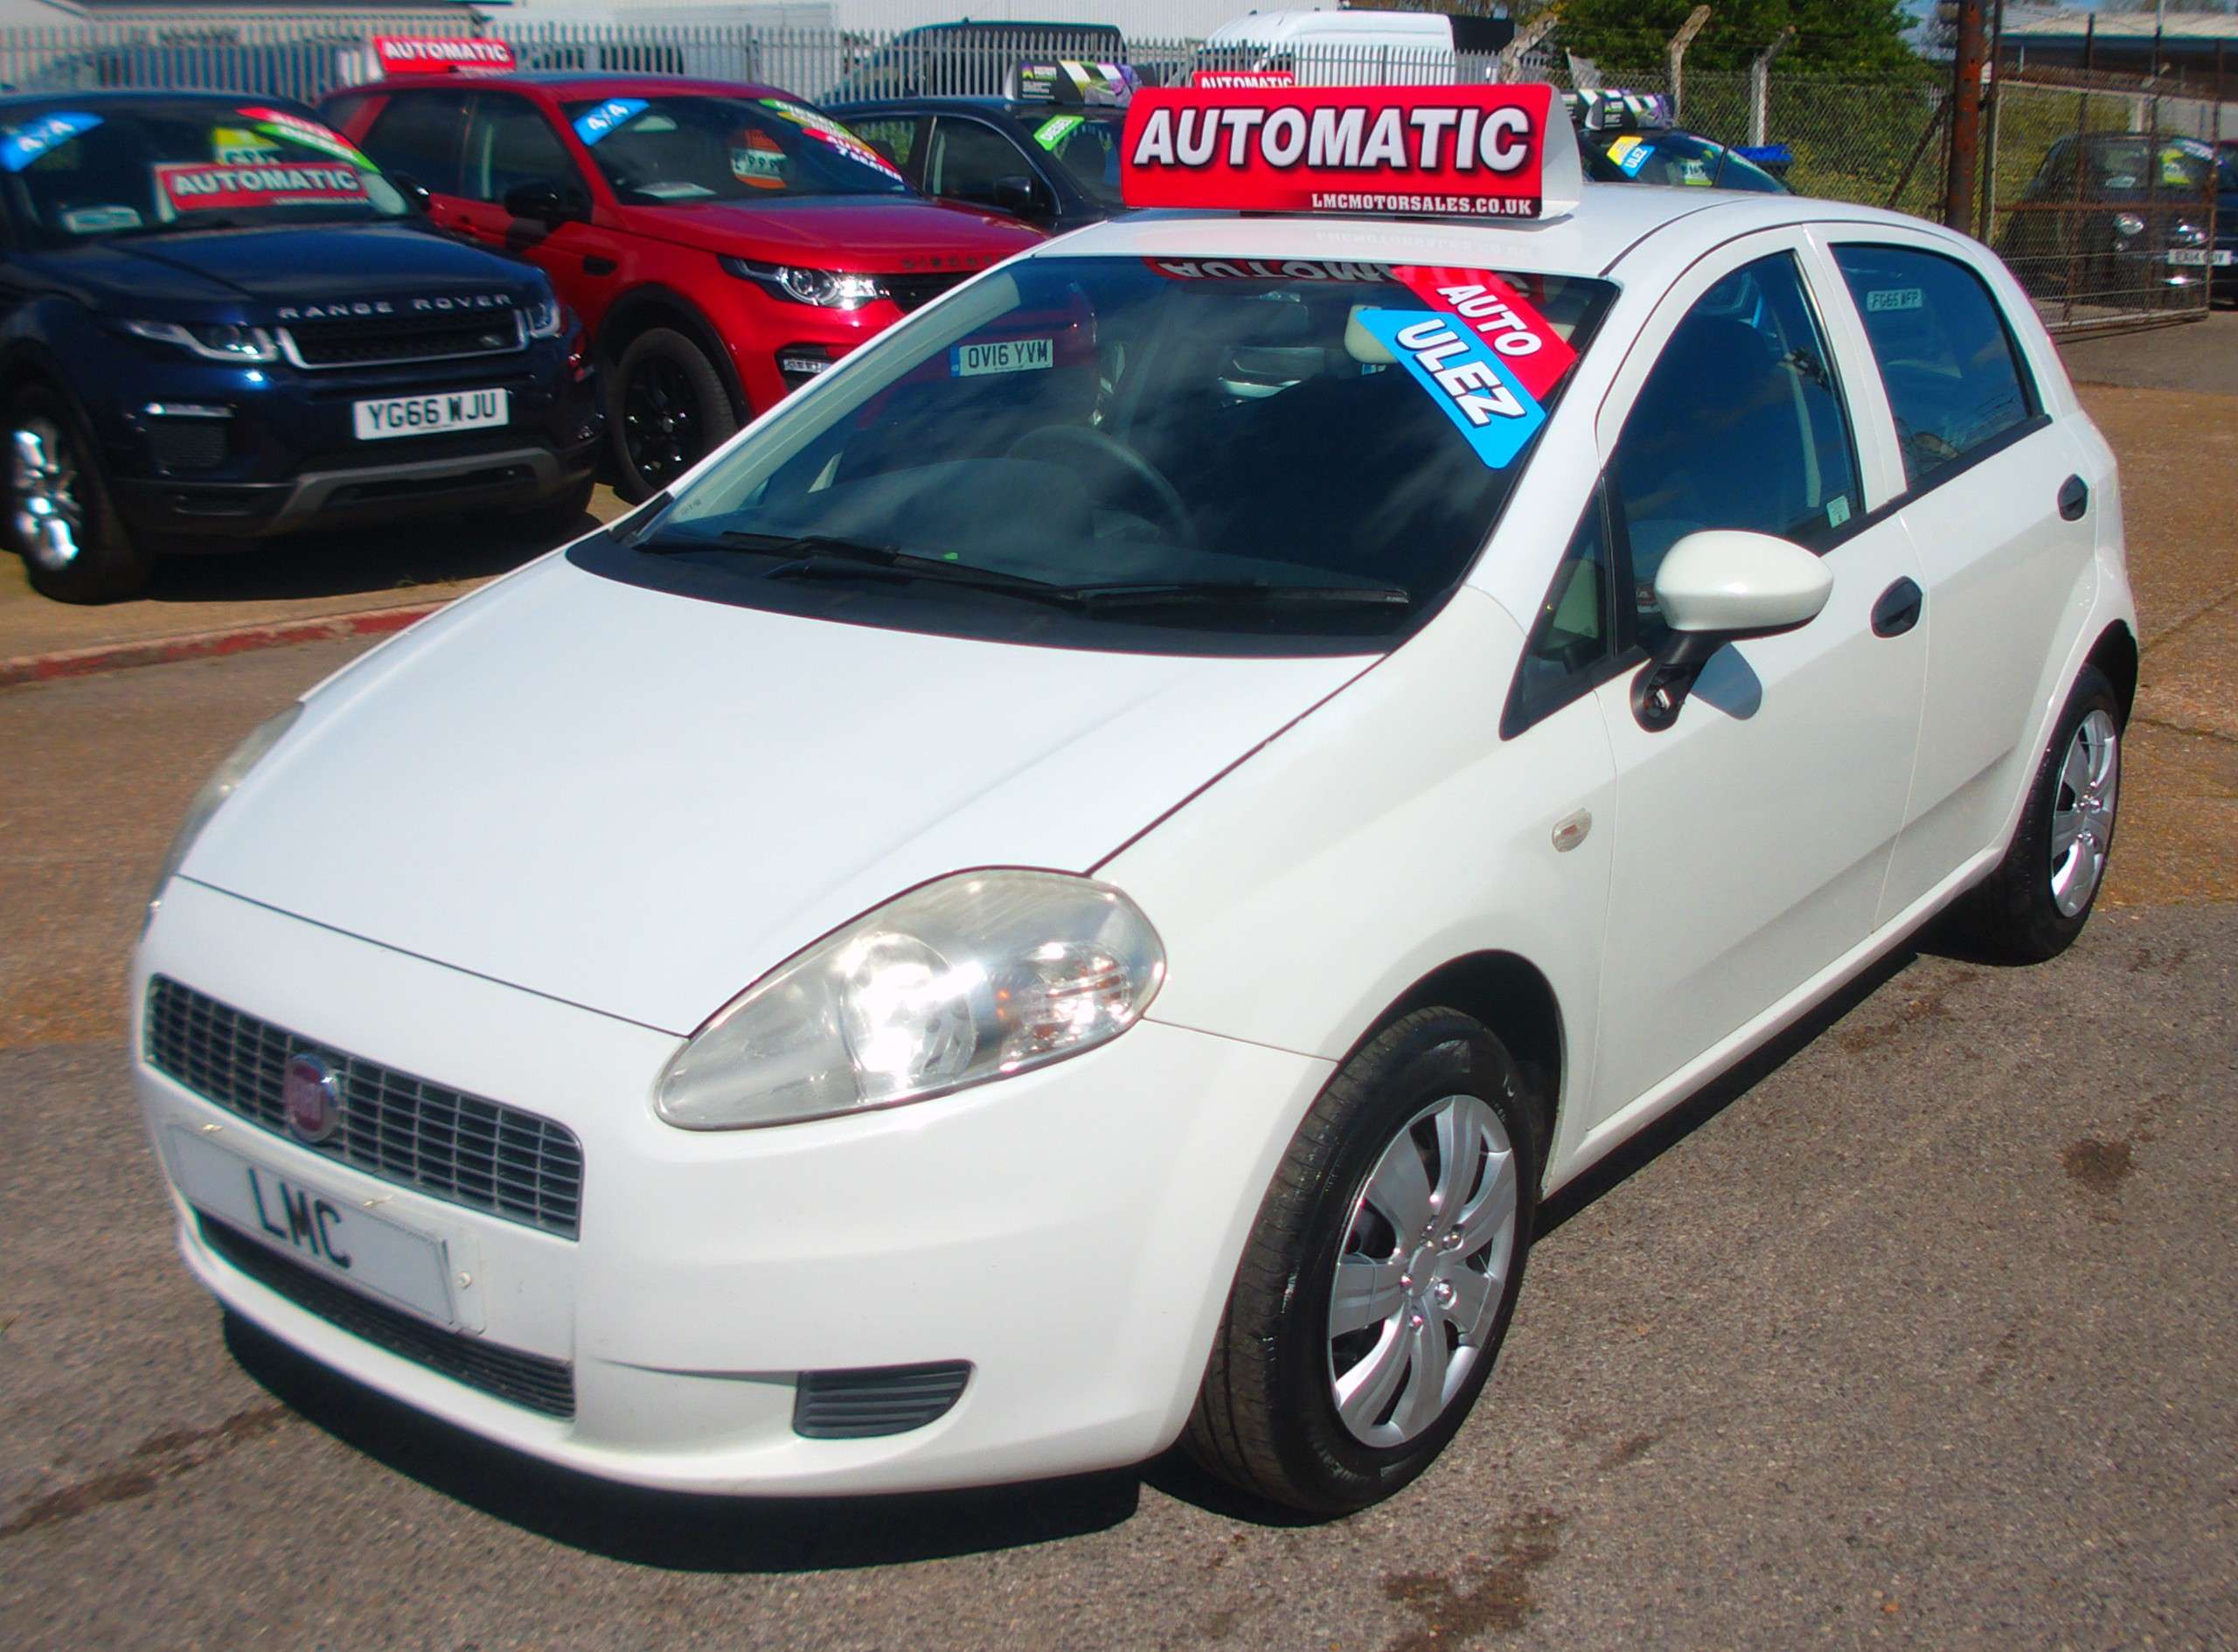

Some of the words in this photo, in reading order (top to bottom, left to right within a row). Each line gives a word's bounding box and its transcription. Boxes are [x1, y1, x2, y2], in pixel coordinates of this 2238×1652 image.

[383, 41, 511, 63] AUTOMATIC
[1133, 106, 1532, 172] AUTOMATIC
[1624, 147, 1648, 169] ULEZ
[174, 170, 358, 197] AUTOMATIC
[1312, 194, 1532, 216] LMCMOTORSALES.CO.UK
[279, 302, 393, 319] RANGE
[412, 294, 512, 310] ROVER
[1436, 284, 1542, 357] AUTO
[968, 346, 1009, 369] OV16
[1012, 341, 1047, 364] YVM
[1394, 318, 1528, 427] ULEZ
[367, 399, 440, 429] YG66
[447, 392, 497, 421] WJU
[248, 1165, 353, 1269] LMC
